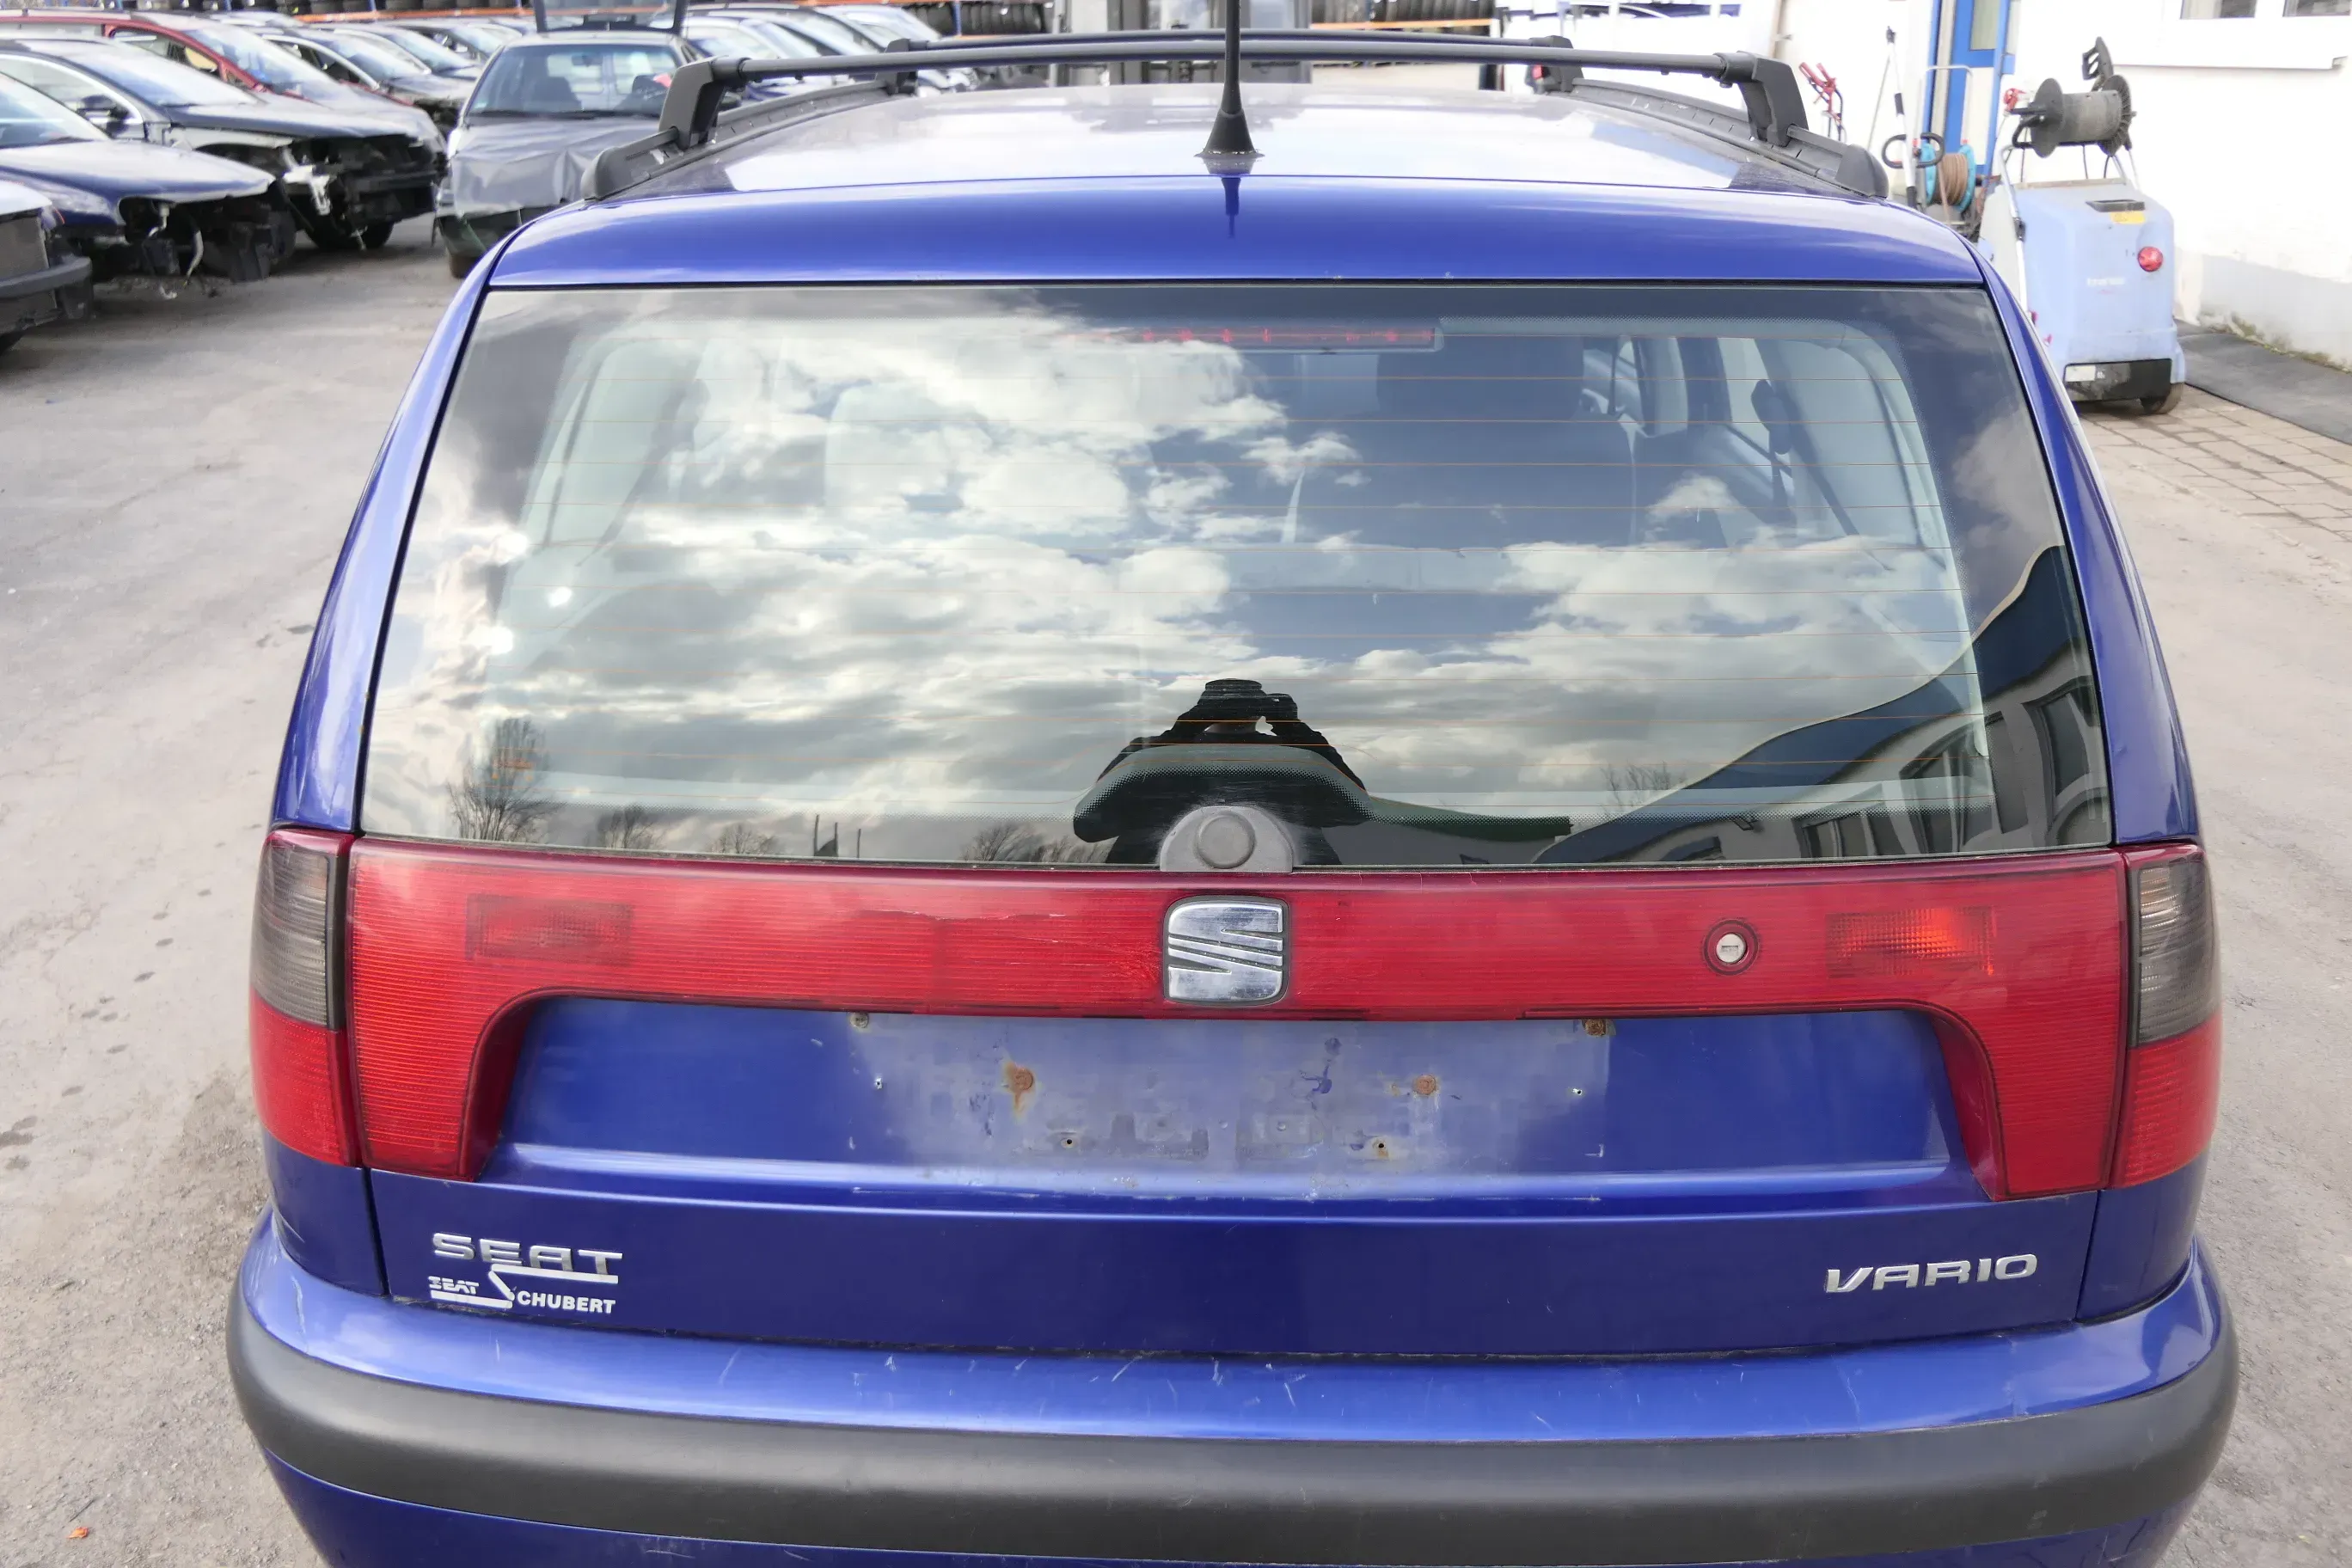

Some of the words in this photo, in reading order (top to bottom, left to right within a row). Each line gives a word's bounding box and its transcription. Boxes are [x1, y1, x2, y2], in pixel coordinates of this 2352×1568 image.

[432, 1232, 623, 1276] SEAT
[1825, 1253, 2037, 1293] VARIO
[428, 1276, 480, 1295] SEAT
